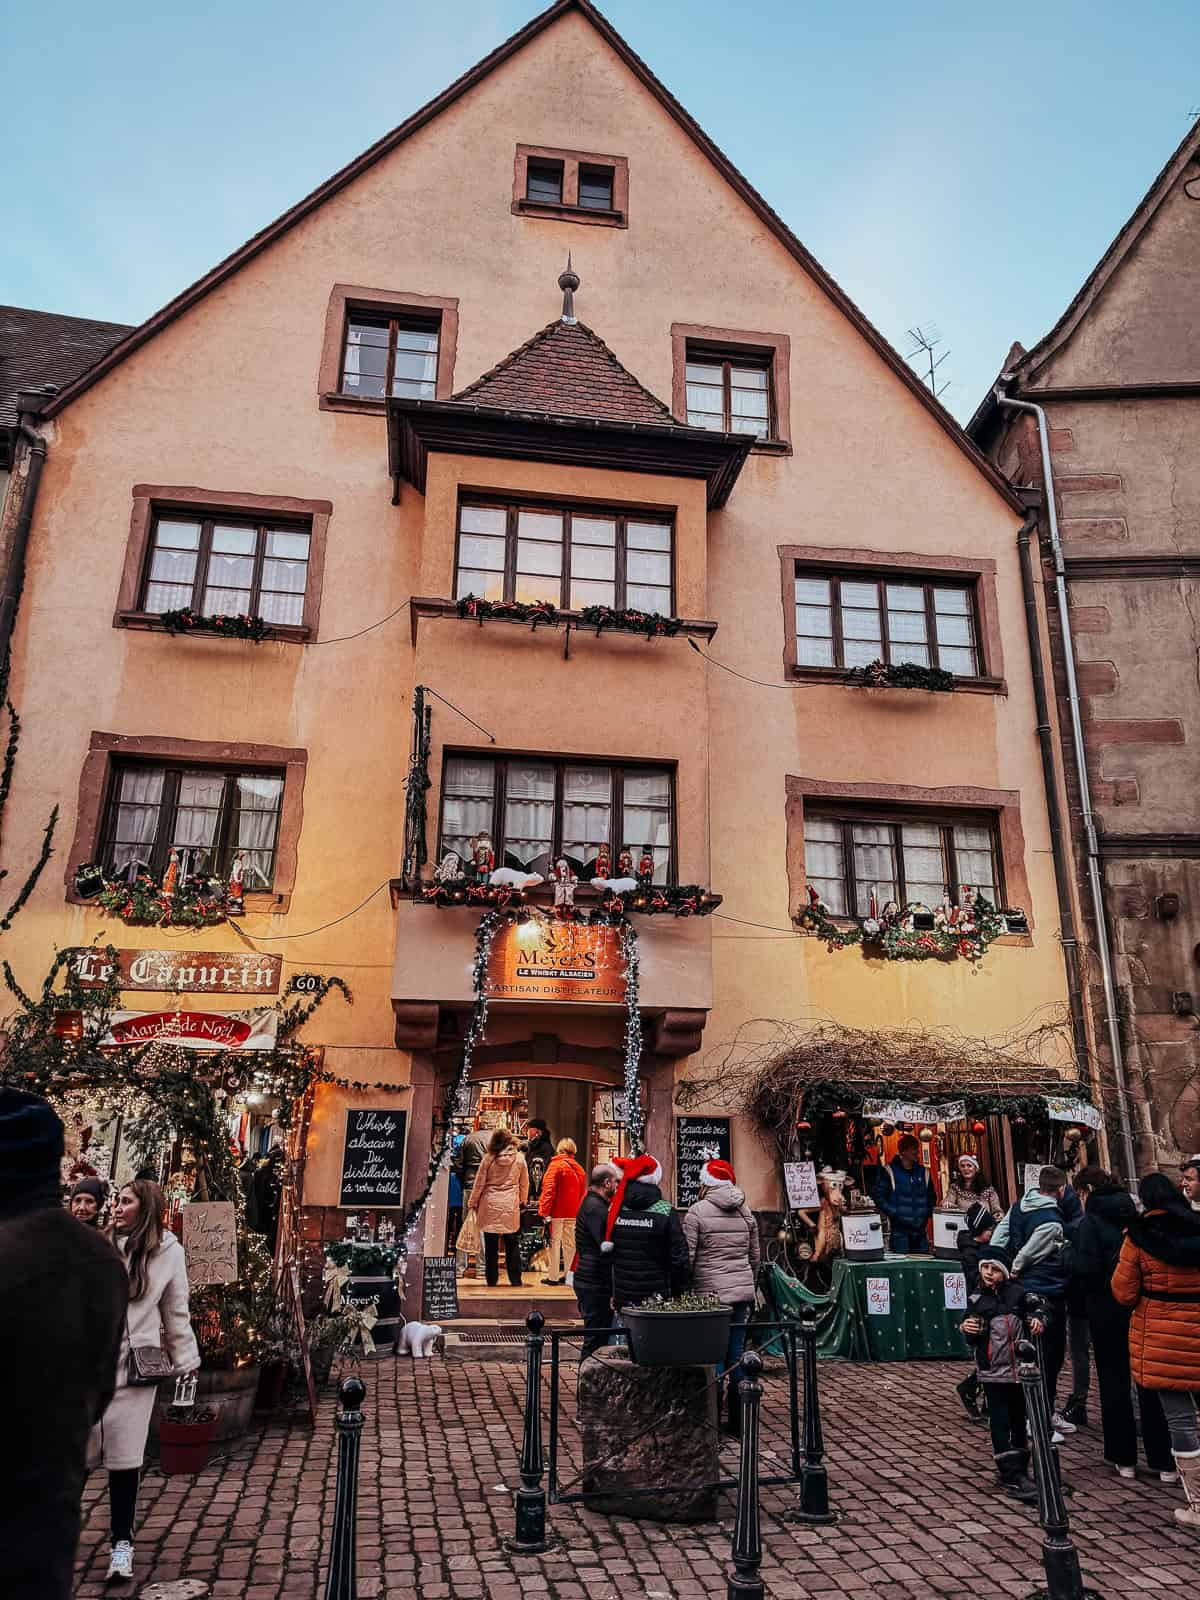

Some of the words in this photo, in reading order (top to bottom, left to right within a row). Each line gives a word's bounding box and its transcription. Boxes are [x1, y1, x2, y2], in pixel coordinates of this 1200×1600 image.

[71, 954, 115, 981] Le
[129, 955, 273, 988] Capucin
[494, 983, 540, 993] ARTISAN
[543, 985, 617, 996] DISTILLATEUR
[124, 1017, 181, 1040] March
[182, 1016, 197, 1032] de
[356, 1112, 396, 1136] Whisky
[348, 1132, 395, 1149] alsacien
[363, 1150, 385, 1164] Du
[343, 1163, 401, 1179] distillateur
[376, 1181, 401, 1194] table
[340, 1294, 380, 1307] Meyer'S
